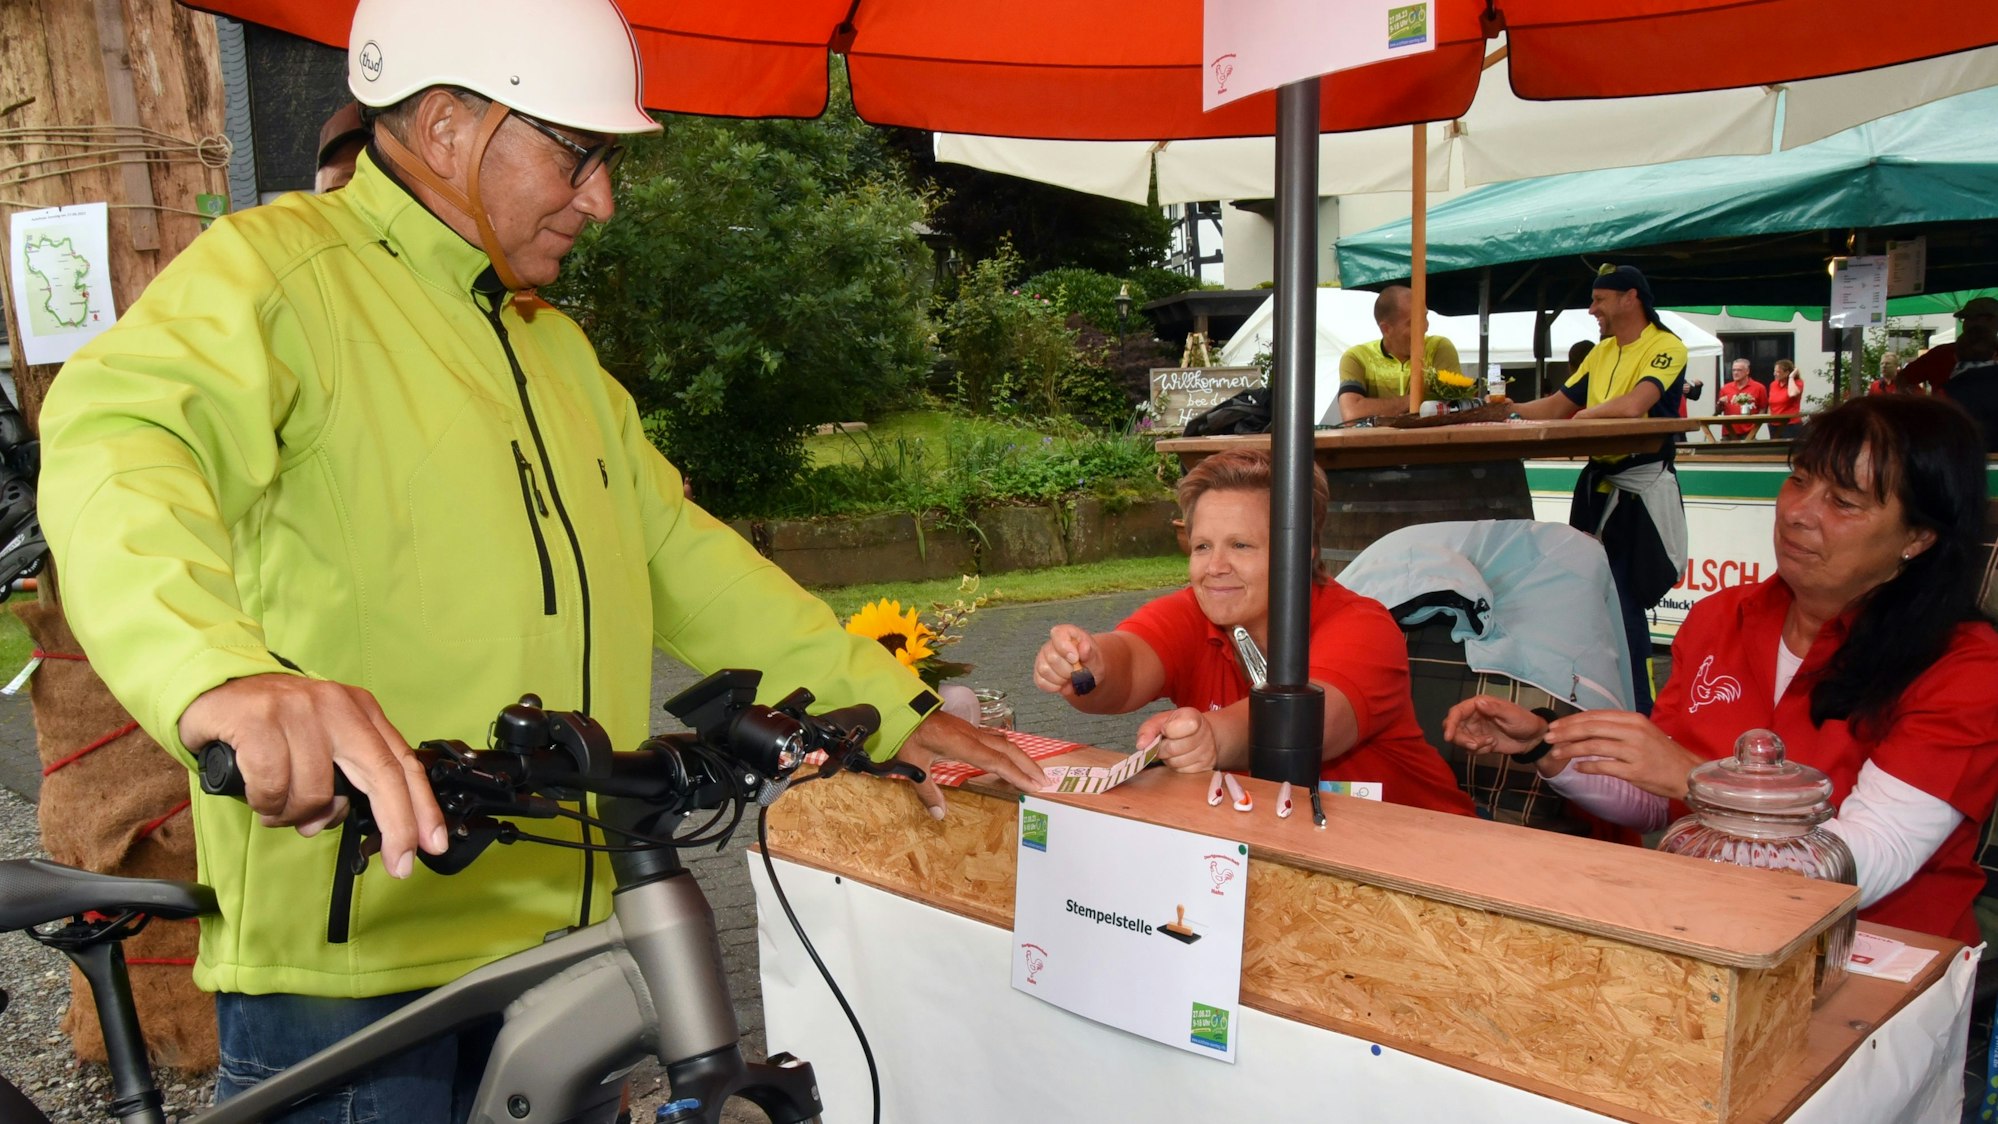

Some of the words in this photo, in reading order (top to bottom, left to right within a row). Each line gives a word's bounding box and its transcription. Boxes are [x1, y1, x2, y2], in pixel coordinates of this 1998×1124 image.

[1153, 370, 1258, 393] Willkommen
[1672, 558, 1759, 592] LSCH
[1066, 899, 1152, 936] Stempelstelle
